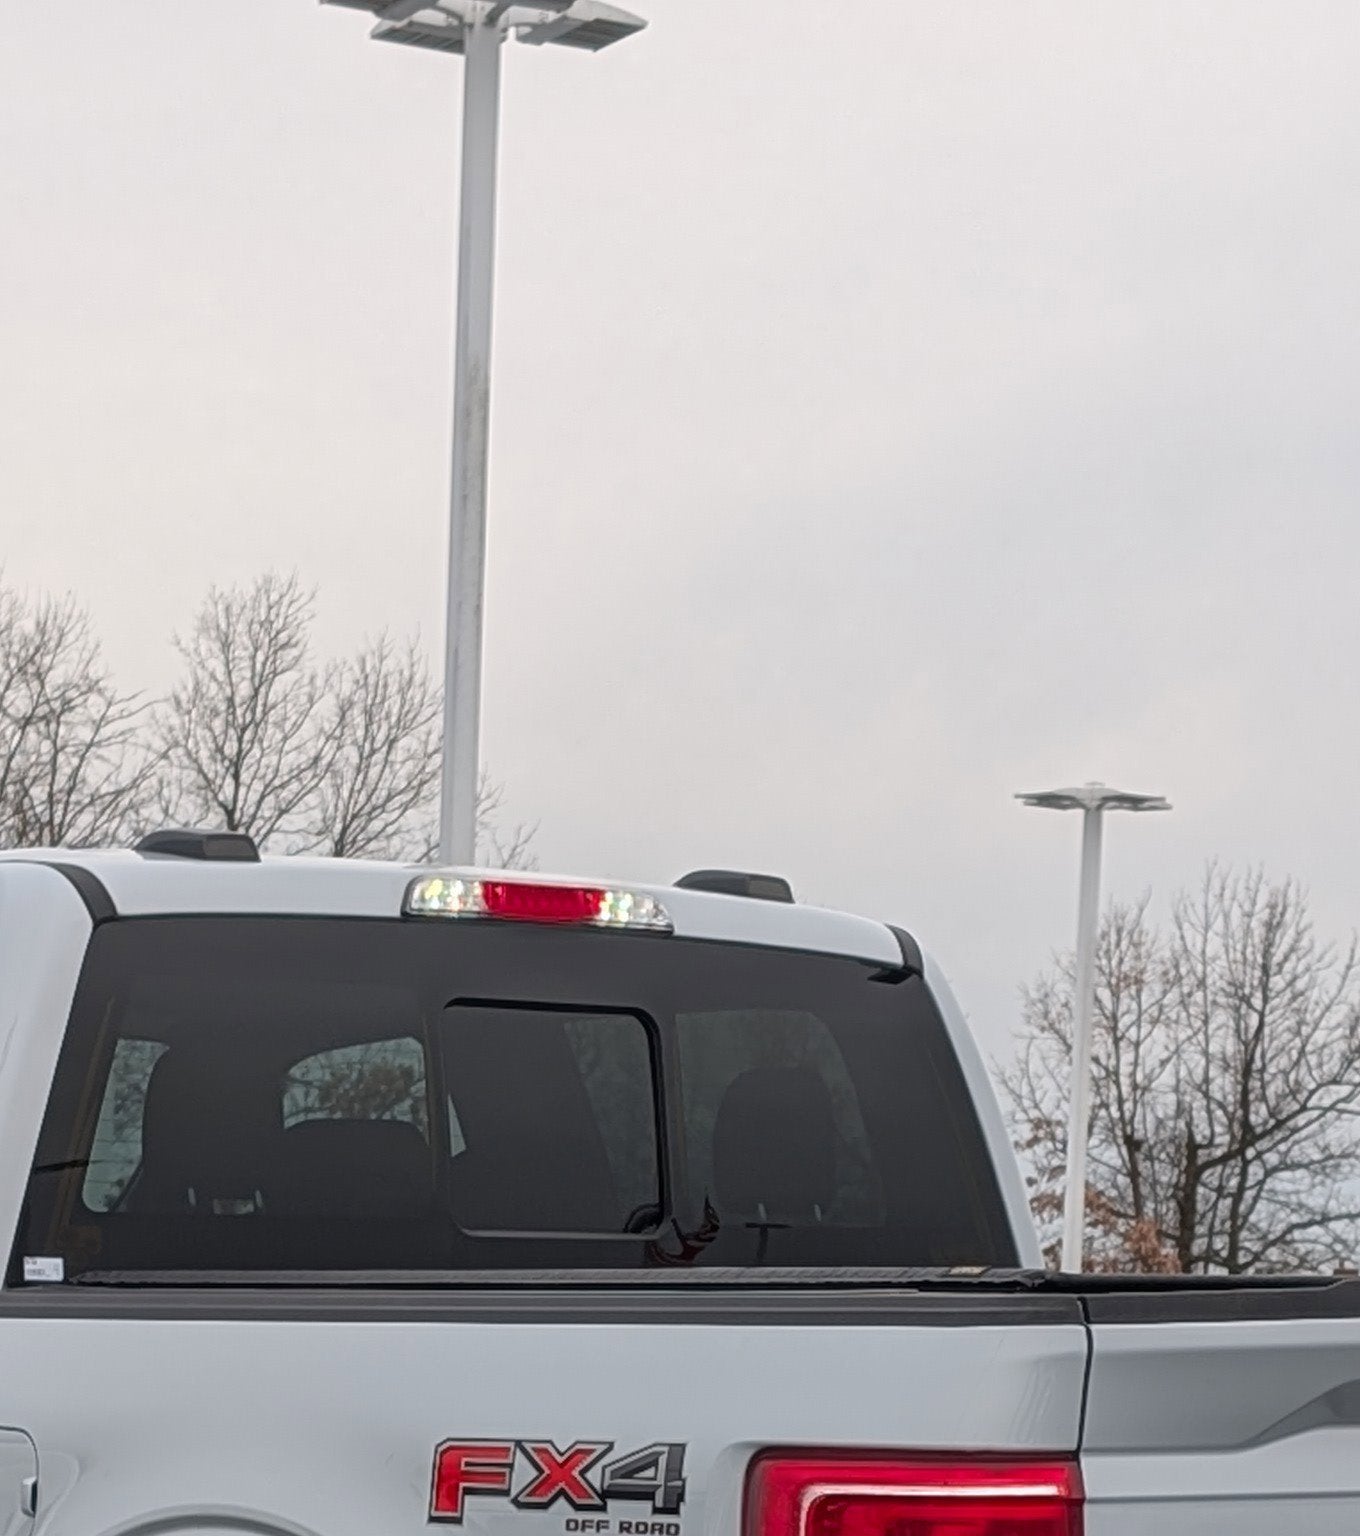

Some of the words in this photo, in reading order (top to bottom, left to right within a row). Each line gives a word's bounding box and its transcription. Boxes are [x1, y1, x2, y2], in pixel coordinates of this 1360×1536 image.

[427, 1437, 687, 1524] FX4
[565, 1518, 610, 1534] OFF
[618, 1520, 681, 1536] ROAD
